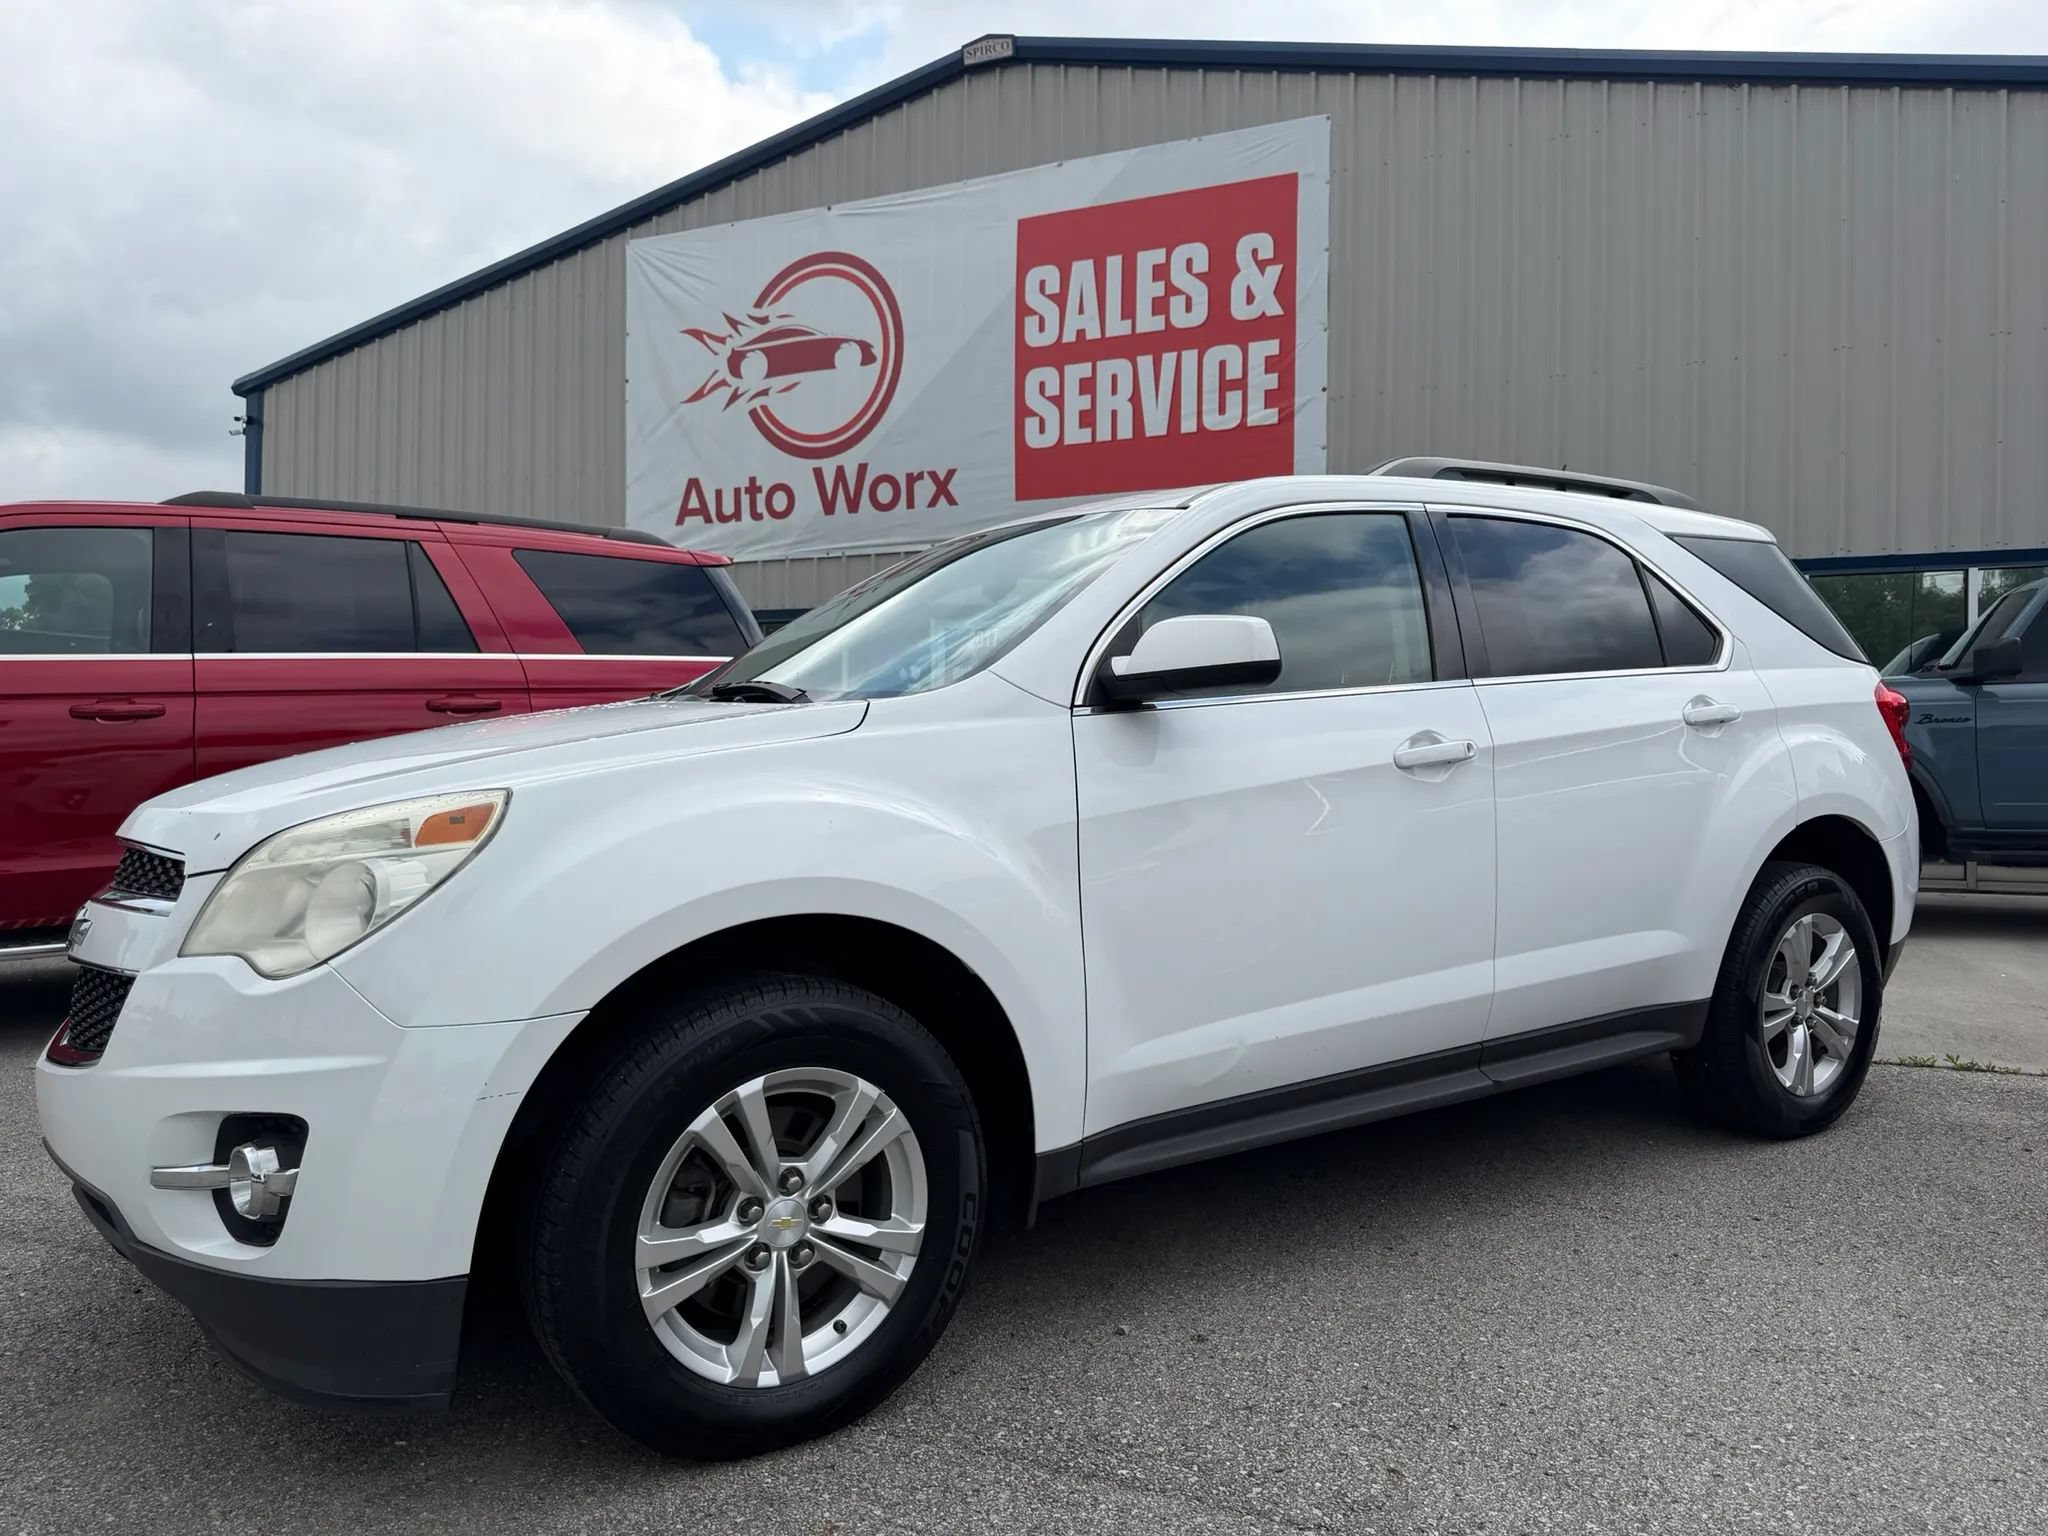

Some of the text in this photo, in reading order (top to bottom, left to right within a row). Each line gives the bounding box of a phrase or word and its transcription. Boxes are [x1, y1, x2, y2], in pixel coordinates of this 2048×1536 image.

[966, 41, 1010, 58] SPIRCO
[1023, 232, 1285, 348] SALES &
[1024, 338, 1281, 449] SERVICE
[675, 462, 959, 527] Auto Worx
[1914, 713, 1973, 725] Bronco
